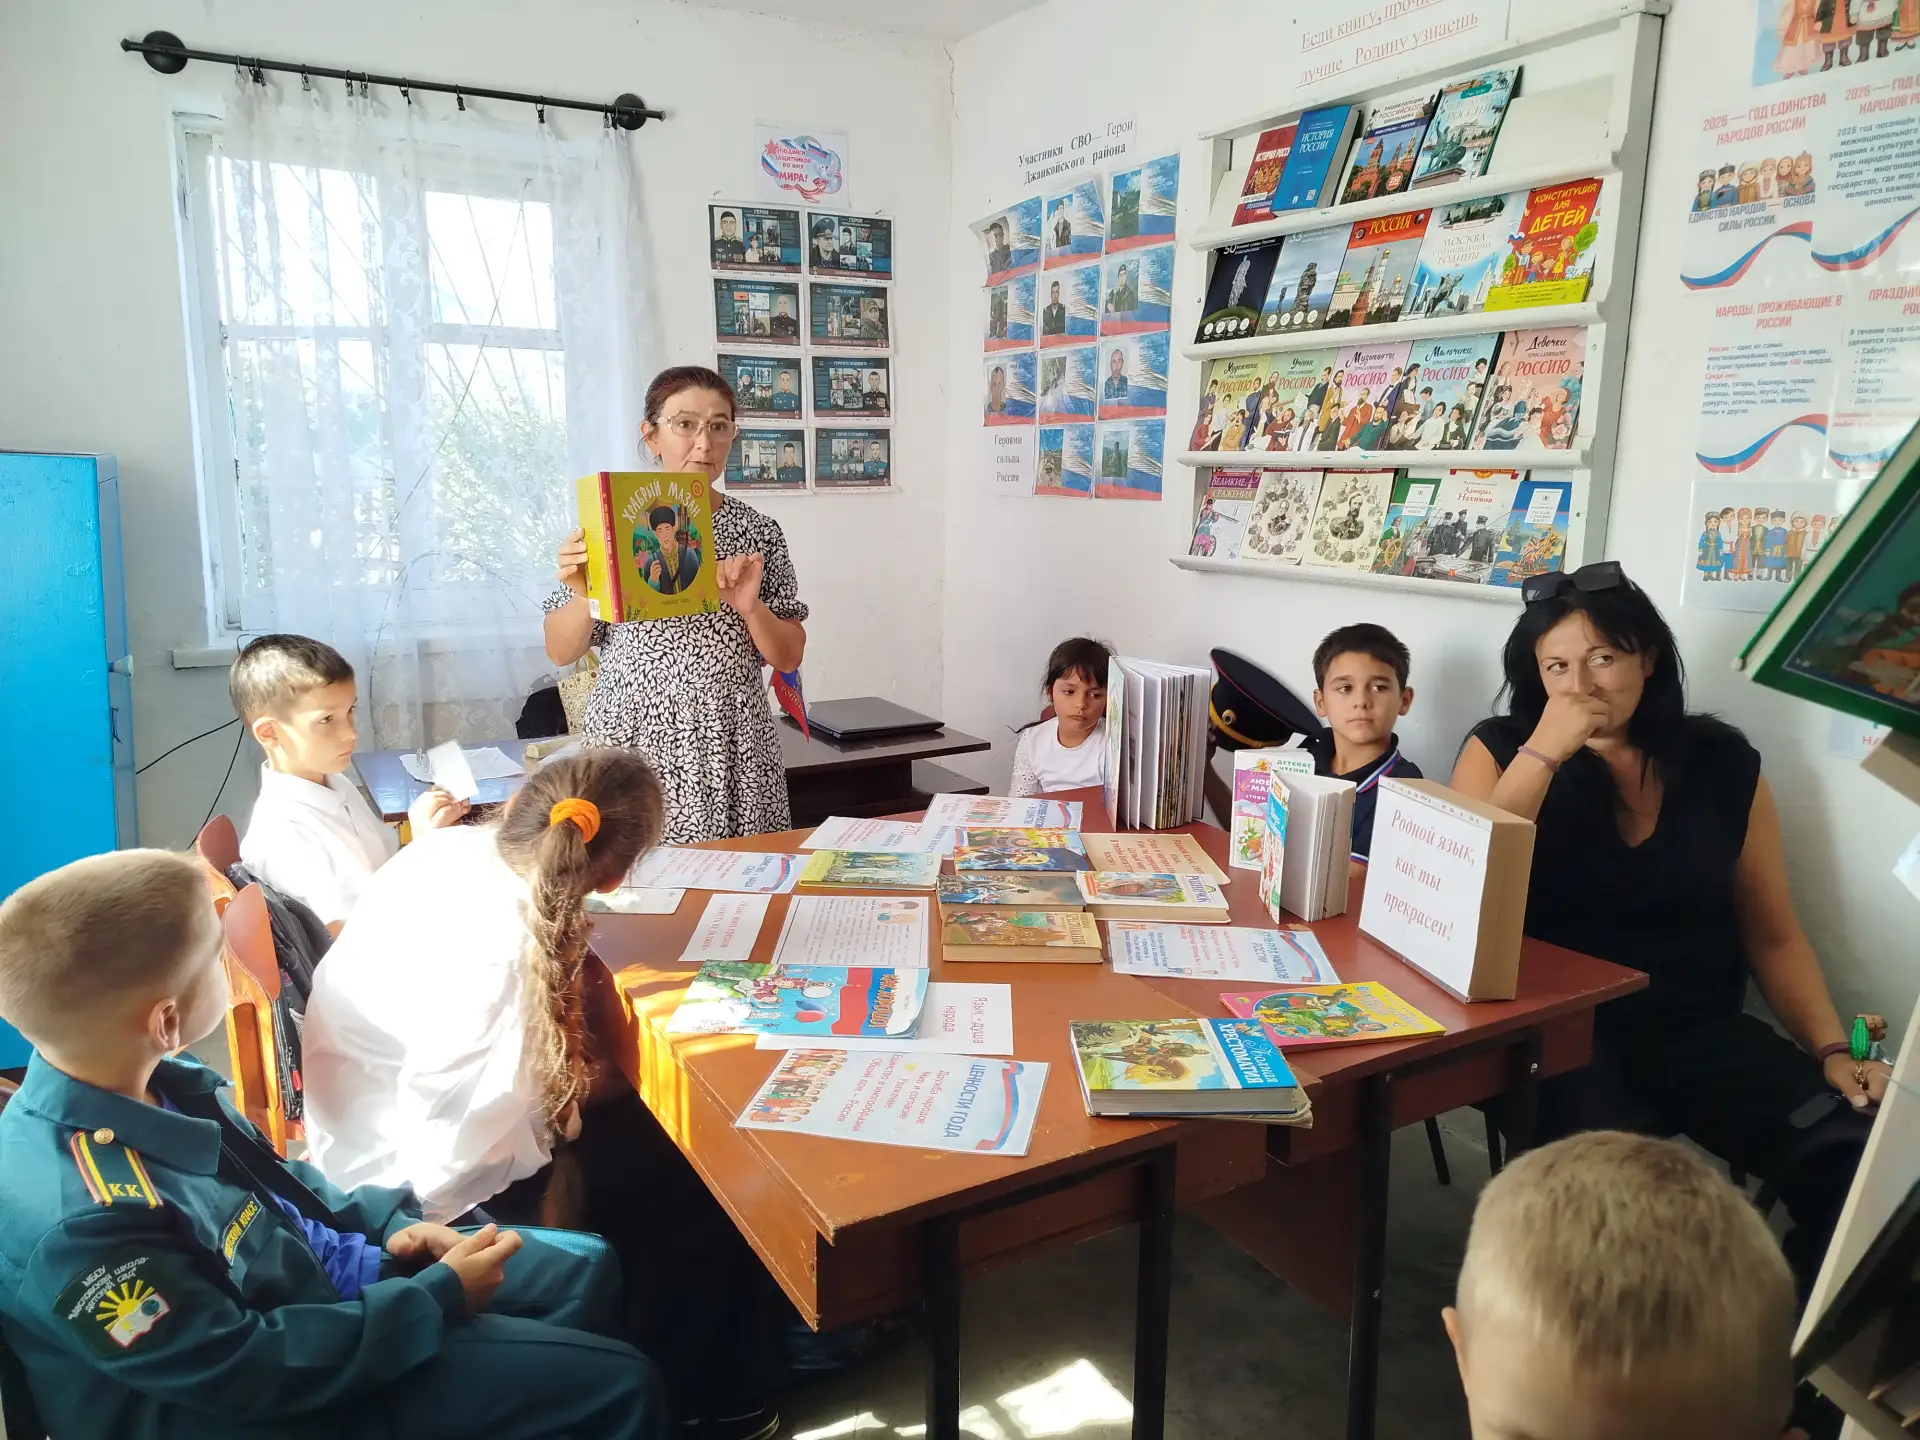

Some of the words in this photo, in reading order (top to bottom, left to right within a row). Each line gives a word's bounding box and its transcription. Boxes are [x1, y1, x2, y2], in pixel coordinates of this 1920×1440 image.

[1302, 29, 1332, 49] Если
[1338, 11, 1382, 36] книгу,
[1300, 59, 1342, 84] лучше
[1356, 36, 1408, 64] Родину
[1412, 12, 1478, 49] узнаешь
[1844, 85, 1870, 100] 2026
[1892, 78, 1914, 91] ГОД
[1379, 103, 1424, 118] РОССИЙСКОГО
[1384, 96, 1424, 111] ЭНЦИКЛОПЕДИЯ
[1703, 115, 1728, 131] 2026
[1748, 106, 1769, 122] ГОД
[1771, 93, 1826, 116] ЕДИНСТВА
[1859, 94, 1908, 114] НАРОДОВ
[1301, 128, 1334, 143] ИСТОРИЯ
[1716, 124, 1764, 146] НАРОДОВ
[1766, 116, 1806, 136] РОССИИ
[1840, 128, 1918, 146] межнационального
[1860, 124, 1872, 134] год
[1019, 145, 1063, 167] Участники
[1108, 120, 1133, 138] Герои
[1299, 140, 1328, 154] РОССИИ
[1830, 148, 1868, 162] уважения
[1878, 138, 1914, 152] культуре
[1024, 156, 1084, 186] Джанкойского
[1092, 143, 1126, 165] района
[1255, 150, 1276, 162] ИСТОРИЯ
[1838, 160, 1858, 169] всех
[1859, 154, 1892, 167] народов
[779, 172, 808, 182] МИРА!
[1828, 178, 1878, 192] государство,
[1882, 175, 1896, 184] где
[1898, 172, 1914, 182] мир
[1836, 169, 1862, 180] Россия
[1534, 183, 1598, 204] КОНСТИТУЦИЯ
[1846, 188, 1882, 199] являются
[1552, 199, 1570, 211] ДЛЯ
[1688, 209, 1728, 224] ЕДИНСТВО
[1729, 202, 1767, 217] НАРОДОВ
[1783, 194, 1816, 208] ОСНОВА
[1370, 215, 1412, 236] РОССИЯ
[1528, 206, 1587, 234] ДЕТЕЙ
[1718, 218, 1742, 232] СИЛЫ
[1744, 215, 1777, 229] РОССИИ.
[1224, 244, 1236, 254] 50
[1442, 234, 1484, 247] МОСКВА
[1716, 304, 1754, 318] НАРОДЫ,
[1757, 296, 1832, 314] ПРОЖИВАЮЩИЕ
[1835, 294, 1843, 306] В
[1756, 316, 1792, 330] РОССИИ
[1421, 366, 1470, 382] РОССИЮ
[1515, 359, 1570, 376] РОССИЮ
[1218, 380, 1252, 393] РОССИЮ
[1278, 376, 1316, 390] РОССИЮ
[1344, 372, 1388, 386] РОССИЮ
[1212, 476, 1247, 488] ВЕЛИКИЕ
[1464, 486, 1491, 495] Адмирал
[622, 480, 662, 524] ХРАБРЫЙ
[668, 482, 700, 518] МАЗАН
[1212, 489, 1254, 500] СРАЖЕНИЯ
[1458, 493, 1493, 503] Нахимов
[1391, 809, 1436, 846] Родной
[1438, 836, 1475, 866] язык,
[1395, 856, 1416, 878] как
[1418, 868, 1442, 891] ты
[1384, 891, 1454, 941] прекрасен!
[1250, 942, 1269, 963] РОССИИ
[1268, 954, 1291, 979] НАРОДОВ
[880, 974, 900, 990] КАК
[868, 989, 895, 1028] ХОРОШО!
[973, 997, 988, 1015] Язык
[942, 1006, 956, 1032] народа
[970, 1022, 984, 1044] душа
[1217, 1022, 1264, 1084] ХРЕСТОМАТИЯ
[860, 1058, 883, 1078] Общий
[878, 1054, 903, 1079] Единство
[853, 1078, 870, 1091] дом
[913, 1071, 930, 1084] Мир
[926, 1070, 949, 1094] Дружба
[951, 1064, 987, 1108] ЦЕННОСТИ
[882, 1077, 909, 1108] Уважение
[835, 1099, 860, 1122] Россия
[849, 1086, 884, 1131] многообразии
[896, 1091, 921, 1119] согласие
[915, 1096, 938, 1124] народов
[941, 1110, 969, 1138] ГОДА
[239, 1201, 257, 1227] КЛАСС
[82, 1265, 106, 1286] МБОУ
